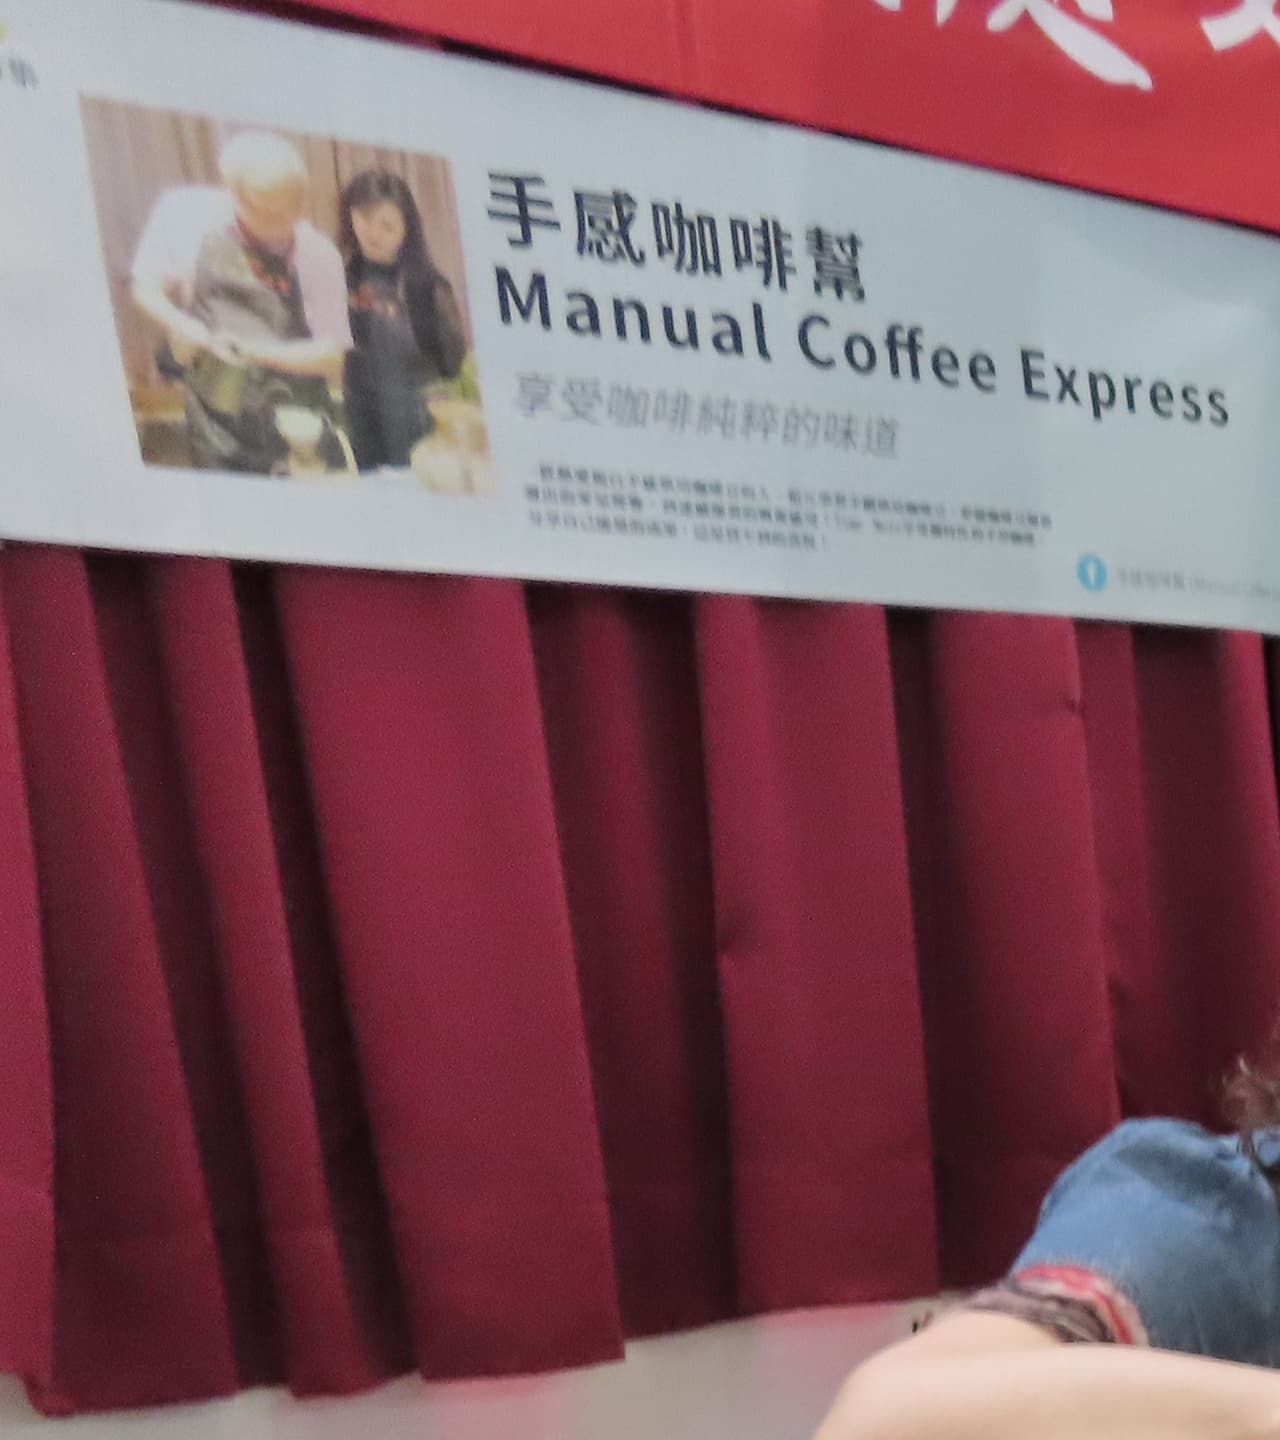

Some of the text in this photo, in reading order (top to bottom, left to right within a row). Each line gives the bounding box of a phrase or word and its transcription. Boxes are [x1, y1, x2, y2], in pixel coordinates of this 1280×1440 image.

[487, 171, 866, 301] 手感咖啡幫
[494, 265, 1228, 427] Manual Coffee Express
[516, 372, 898, 459] 享受咖啡純粹的味道
